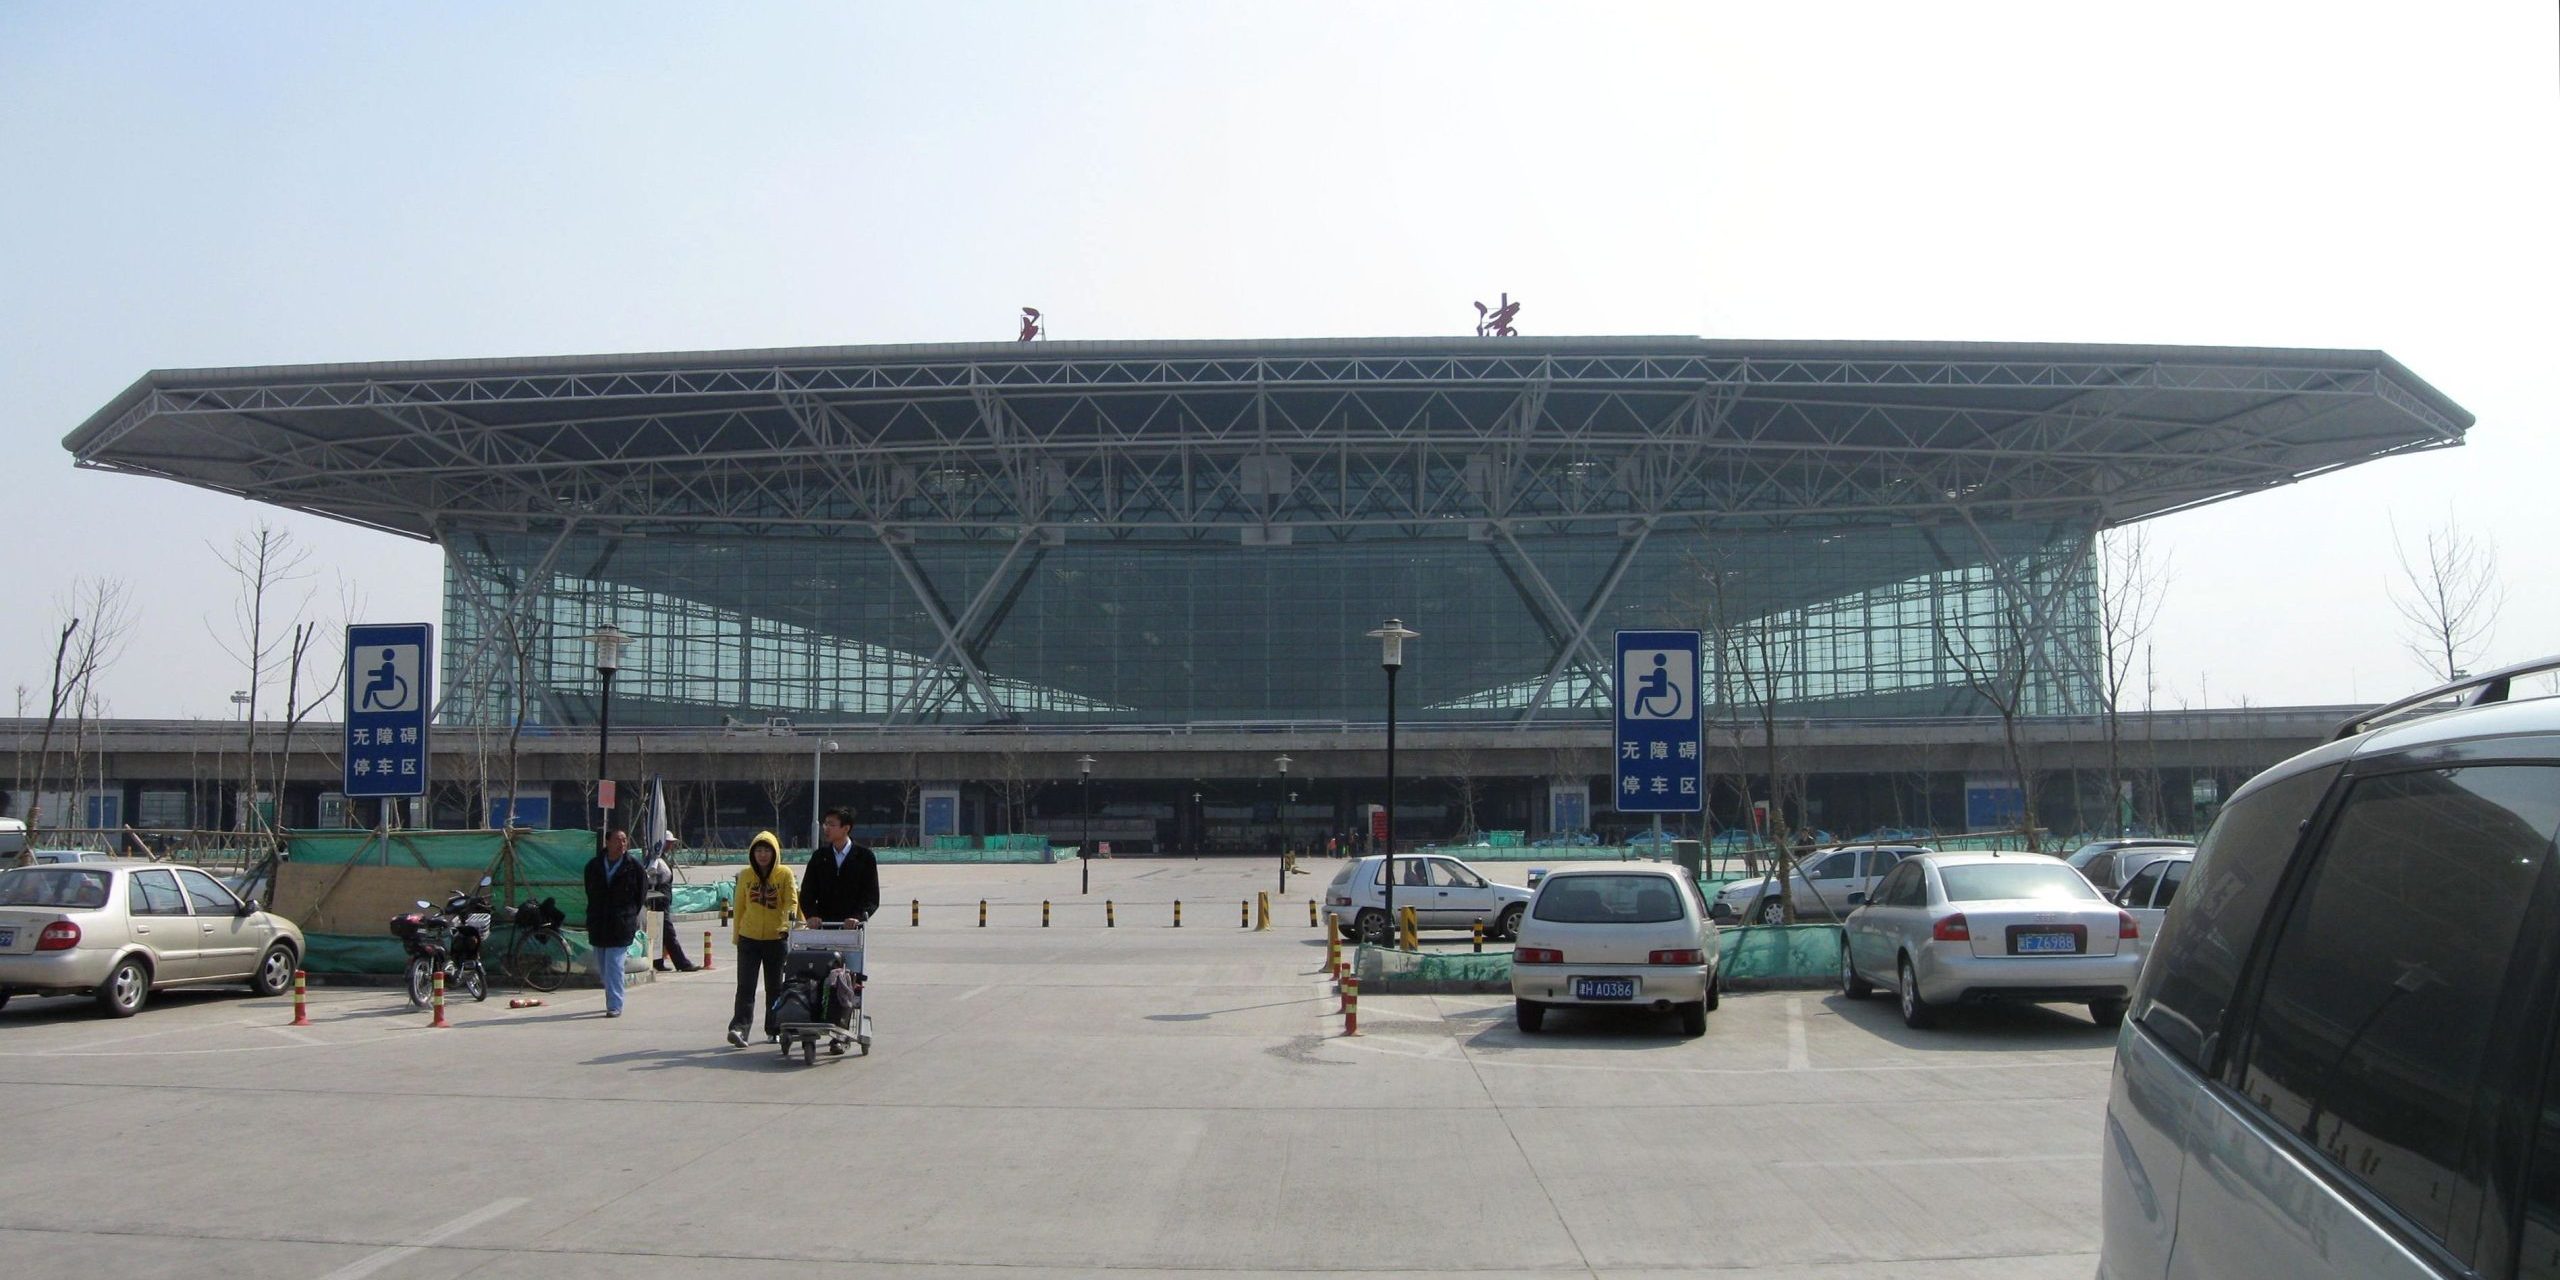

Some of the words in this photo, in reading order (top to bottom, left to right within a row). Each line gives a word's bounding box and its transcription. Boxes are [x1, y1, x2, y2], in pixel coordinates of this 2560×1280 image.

[353, 727, 417, 745] 无障碍
[1622, 741, 1697, 759] 无障碍
[353, 758, 417, 776] 停车区
[1622, 776, 1697, 794] 停车区
[2037, 936, 2073, 949] Z6988
[1596, 983, 1632, 996] A0386
